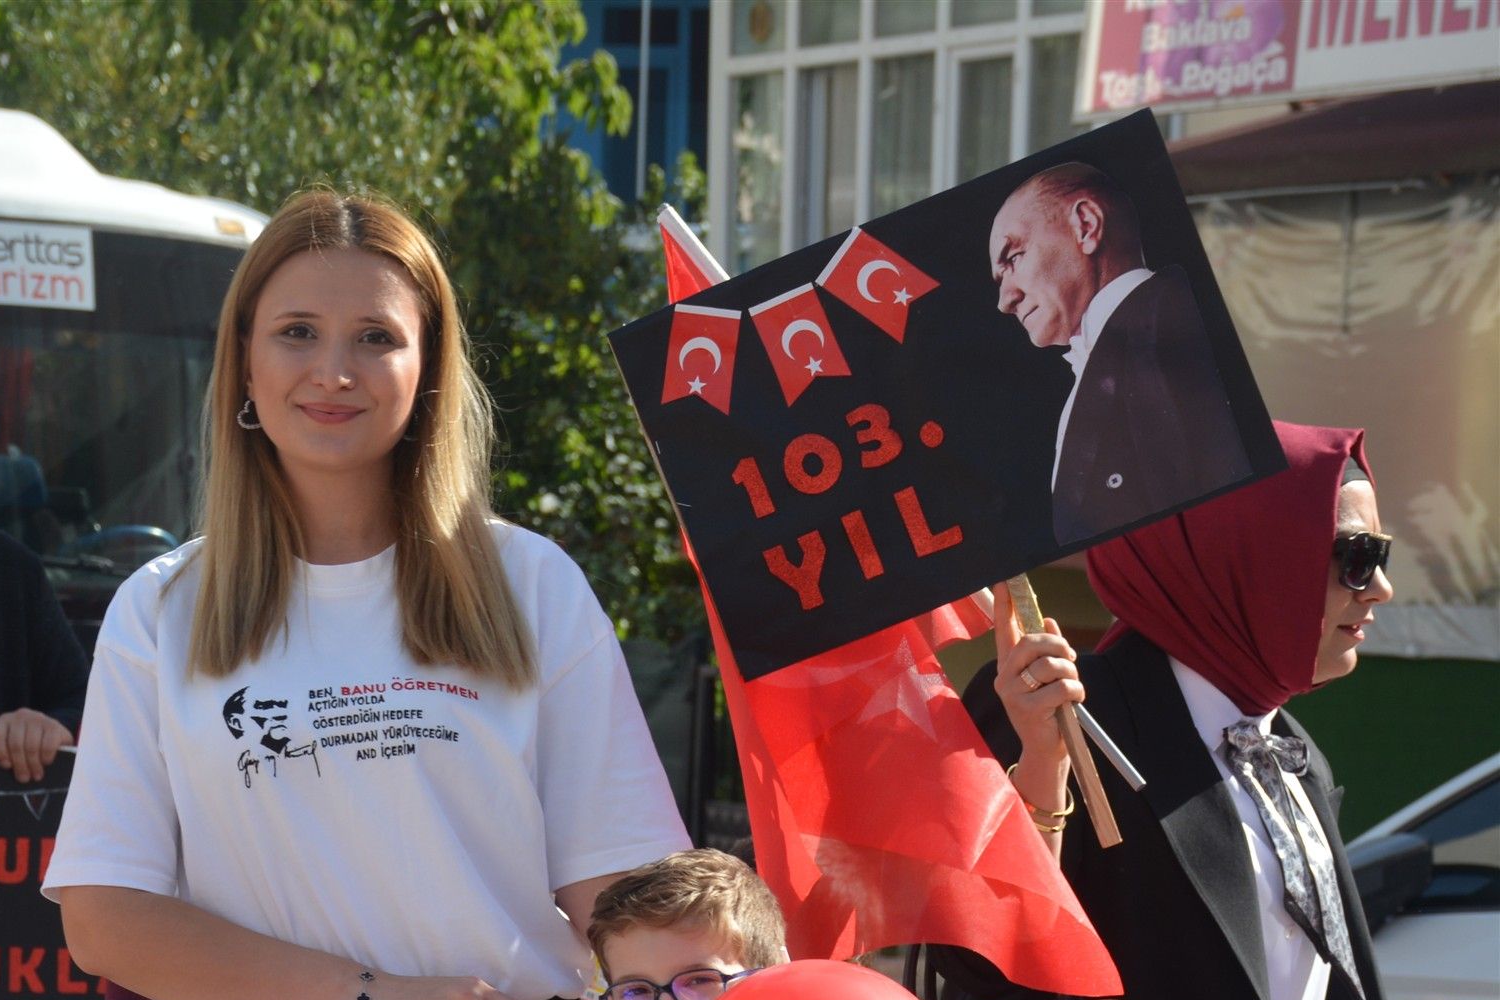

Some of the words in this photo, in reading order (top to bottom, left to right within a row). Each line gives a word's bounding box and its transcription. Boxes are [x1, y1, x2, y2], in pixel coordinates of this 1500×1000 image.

[731, 403, 945, 519] 103.
[762, 485, 964, 611] YIL
[308, 686, 333, 700] BEN
[340, 683, 387, 697] BANU
[390, 677, 479, 701] ÖĞRETMEN
[350, 694, 386, 706] YOLDA
[382, 709, 424, 722] HEDEFE
[320, 730, 379, 748] DURMADAN
[356, 749, 377, 761] AND
